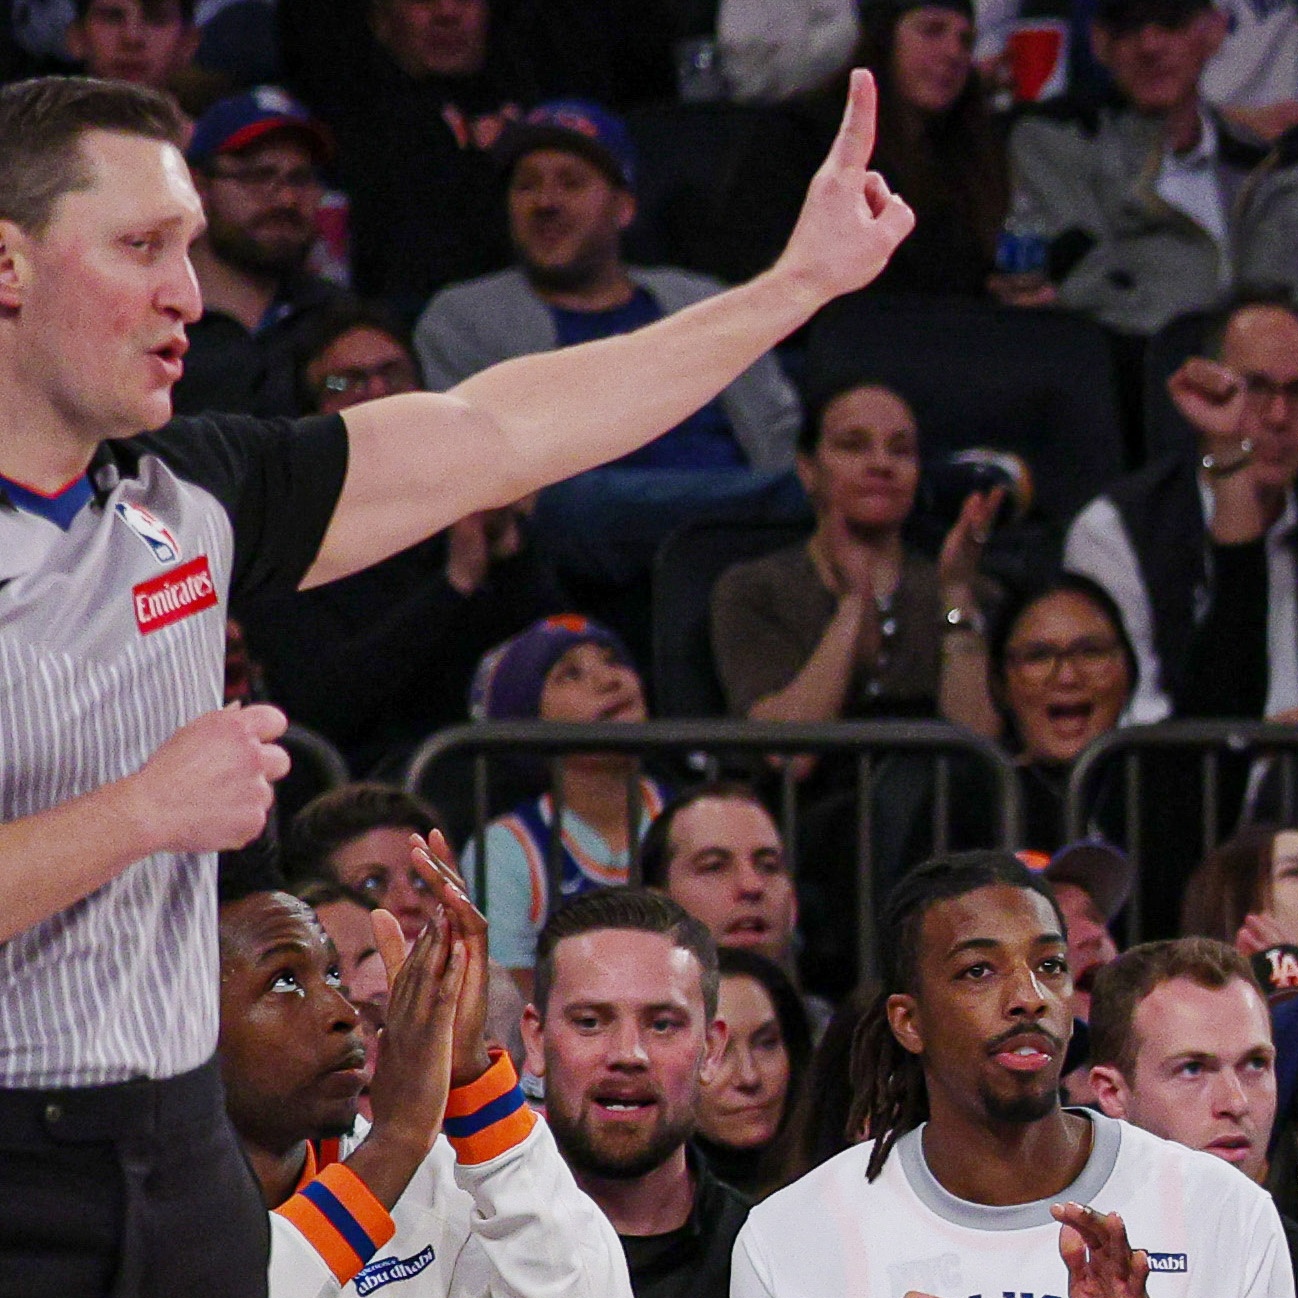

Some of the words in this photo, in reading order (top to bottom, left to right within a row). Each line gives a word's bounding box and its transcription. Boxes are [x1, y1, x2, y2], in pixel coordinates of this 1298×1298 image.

[135, 570, 213, 623] Emirates
[358, 1275, 390, 1295] abu
[390, 1247, 433, 1279] dhabi
[1147, 1255, 1185, 1270] habi
